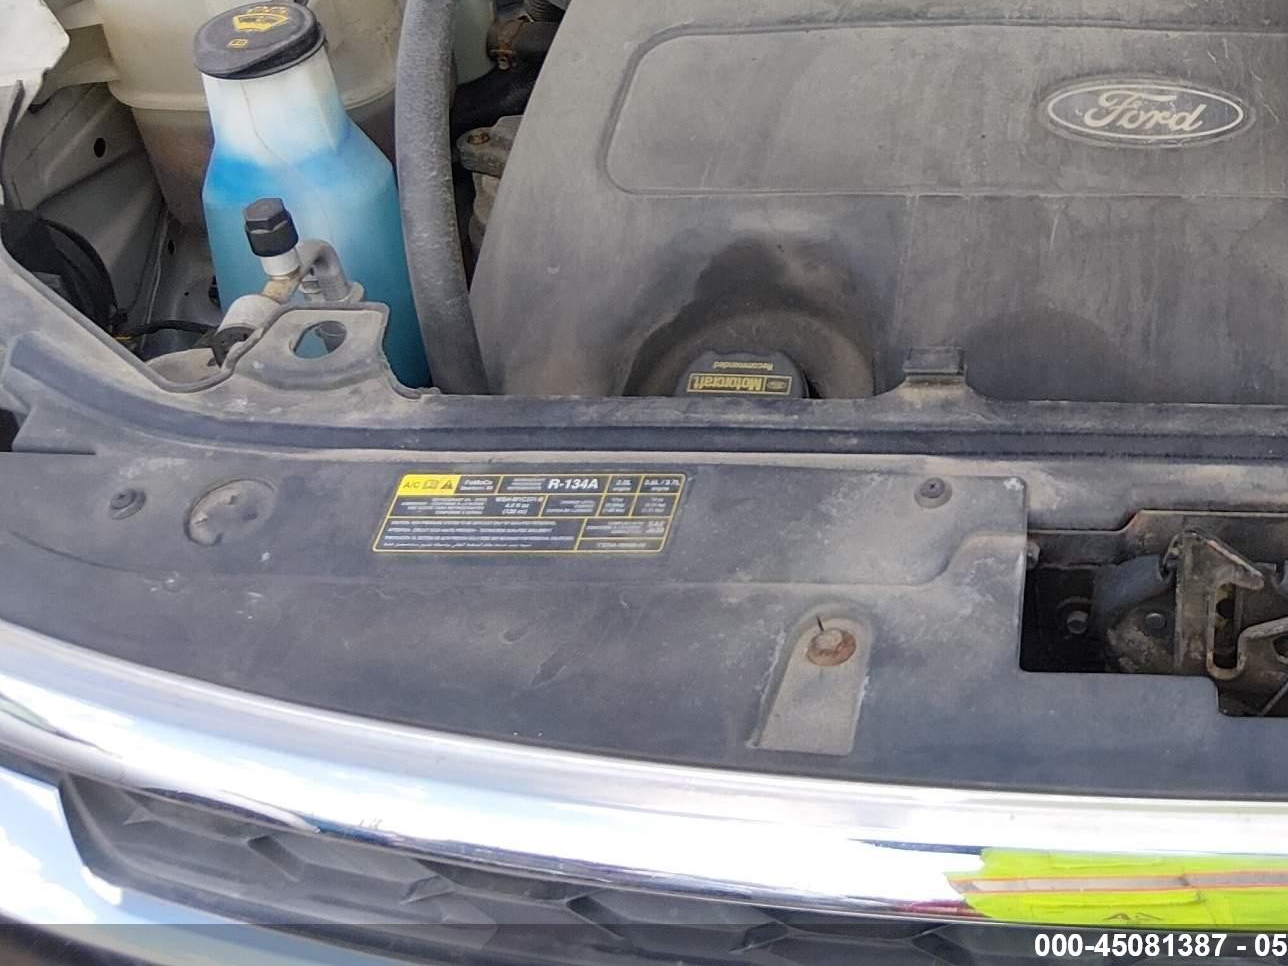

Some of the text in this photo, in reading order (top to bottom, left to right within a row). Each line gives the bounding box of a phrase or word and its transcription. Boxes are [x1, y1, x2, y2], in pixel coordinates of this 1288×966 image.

[1084, 90, 1208, 132] Ford
[713, 361, 774, 371] Recommended
[693, 376, 763, 391] Motorcraft
[402, 481, 420, 489] A/C
[547, 478, 599, 490] R-134A
